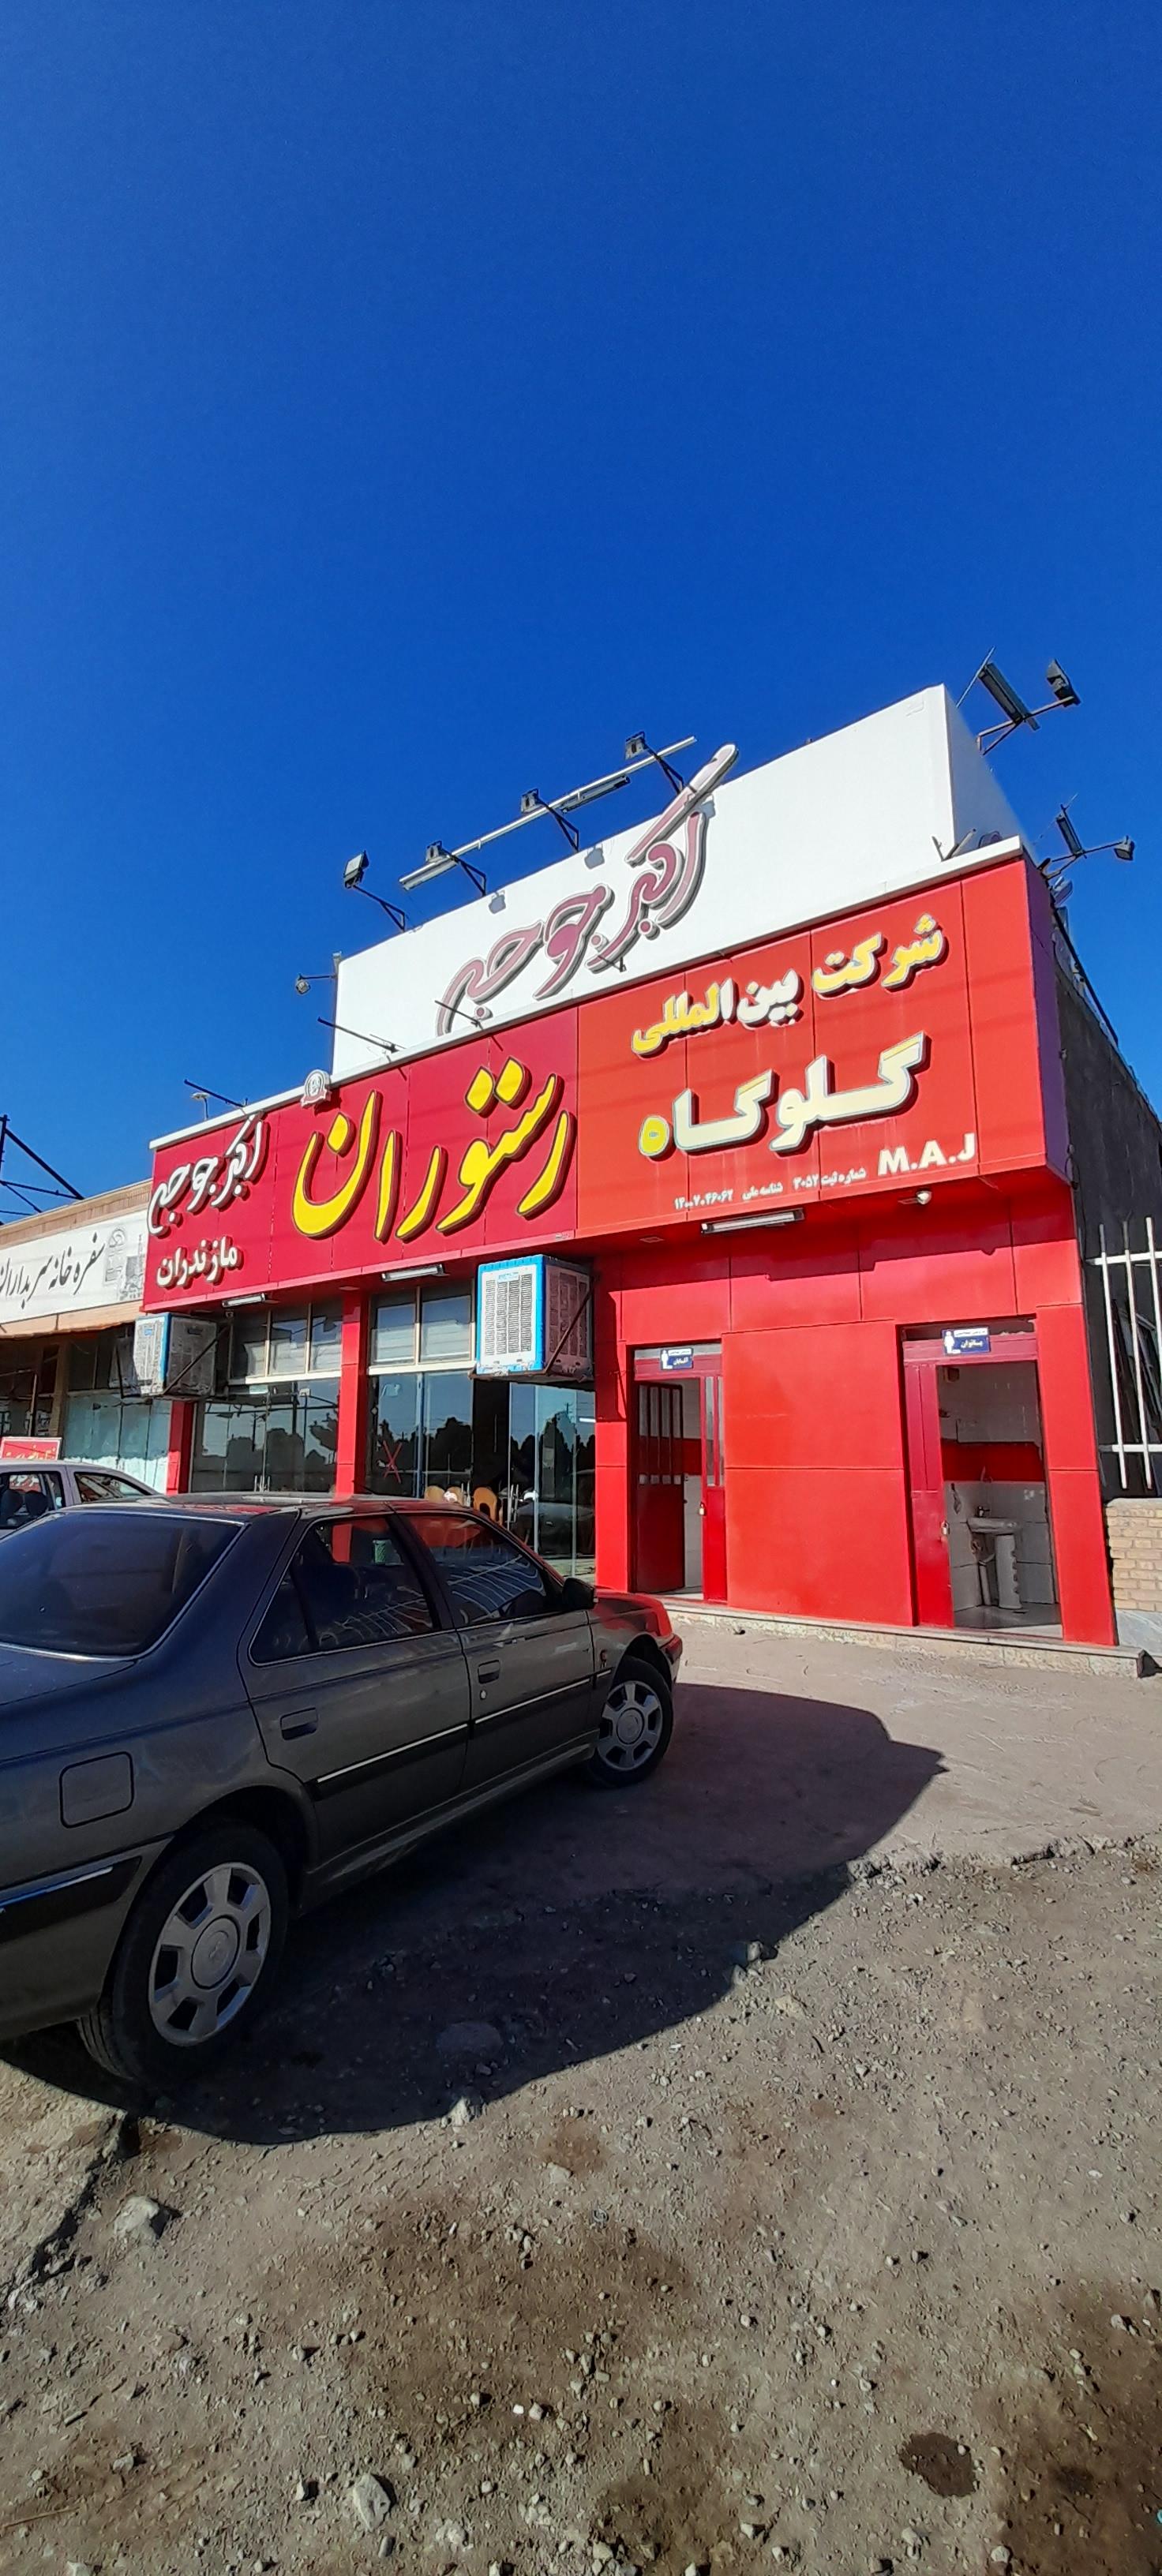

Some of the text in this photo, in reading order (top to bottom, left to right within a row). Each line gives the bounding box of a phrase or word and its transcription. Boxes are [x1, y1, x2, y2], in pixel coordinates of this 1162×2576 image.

[584, 743, 739, 974] اکبر
[812, 912, 947, 996] شرکت
[638, 1031, 932, 1159] گلوگاه
[211, 1110, 267, 1209] اکبر
[291, 1056, 576, 1243] رستوران
[877, 1132, 976, 1177] M.A.J
[156, 1235, 243, 1289] مازندران
